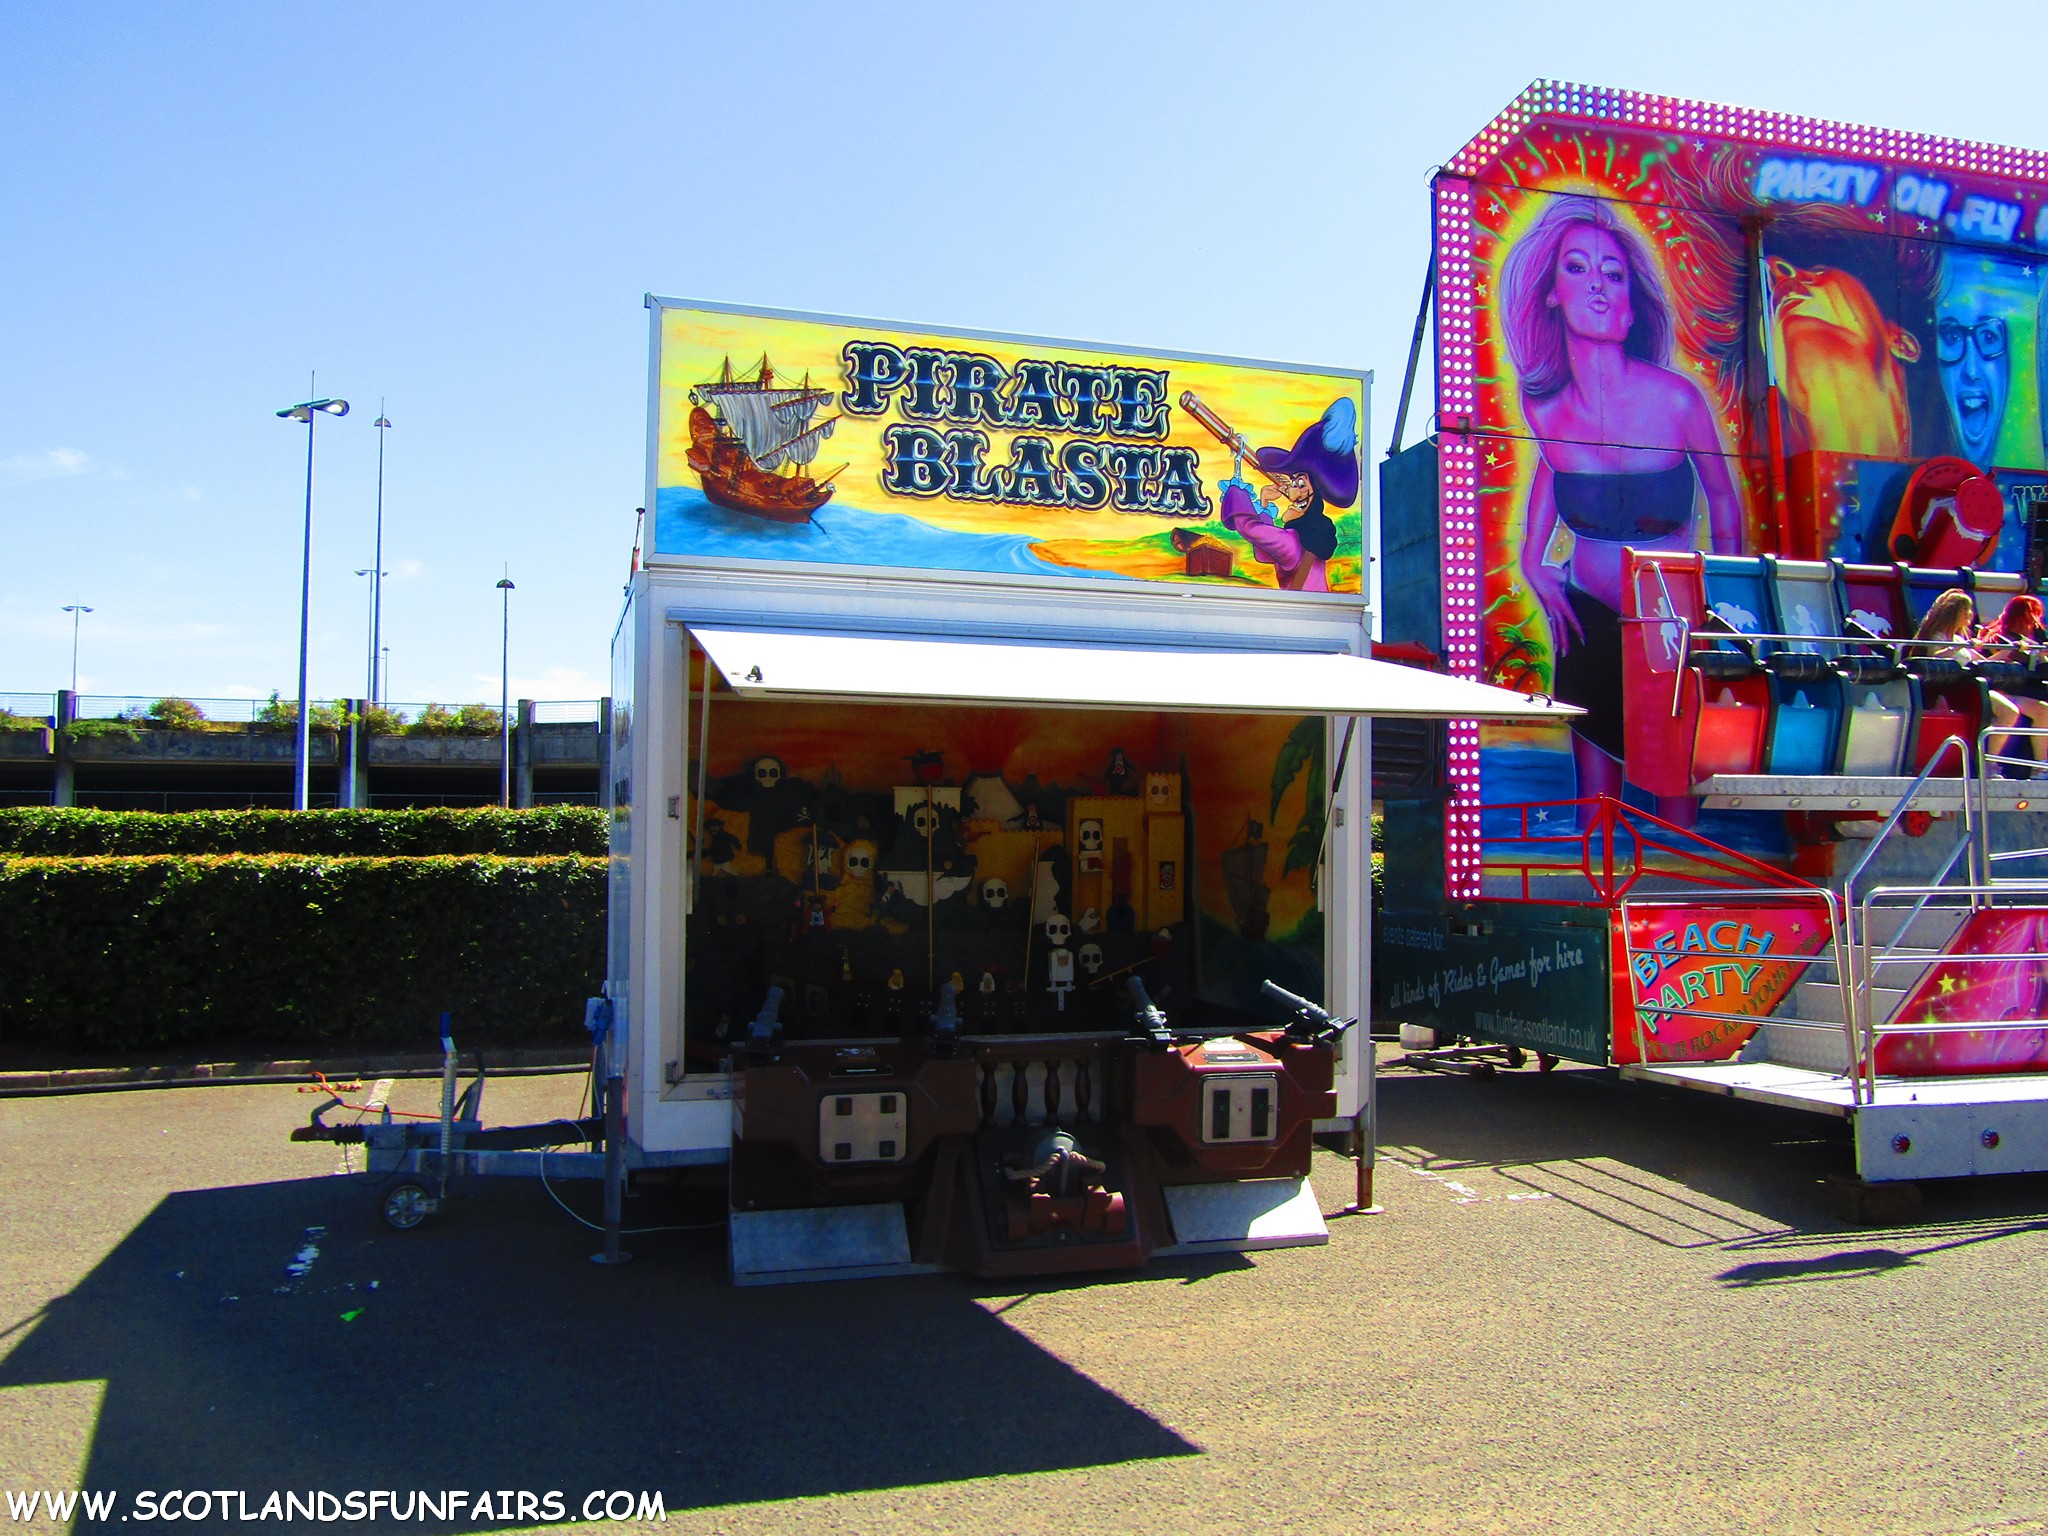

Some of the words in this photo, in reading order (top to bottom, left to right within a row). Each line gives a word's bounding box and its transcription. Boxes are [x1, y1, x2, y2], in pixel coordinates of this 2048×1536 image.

[1758, 158, 1878, 204] PARTY
[1961, 196, 2021, 241] FLY
[841, 340, 1171, 441] PIRATE
[882, 423, 1213, 517] BLASTA
[1403, 976, 1425, 1005] kinds
[1427, 972, 1440, 1007] of
[1443, 965, 1473, 995] Rides
[1476, 965, 1487, 987] &
[1489, 956, 1526, 994] Games
[1530, 947, 1552, 988] for
[1556, 941, 1584, 970] hire
[1632, 920, 1775, 988] BEACH
[1474, 1009, 1597, 1052] www.funfair-scotland.co.uk
[1638, 963, 1763, 1035] PARTY
